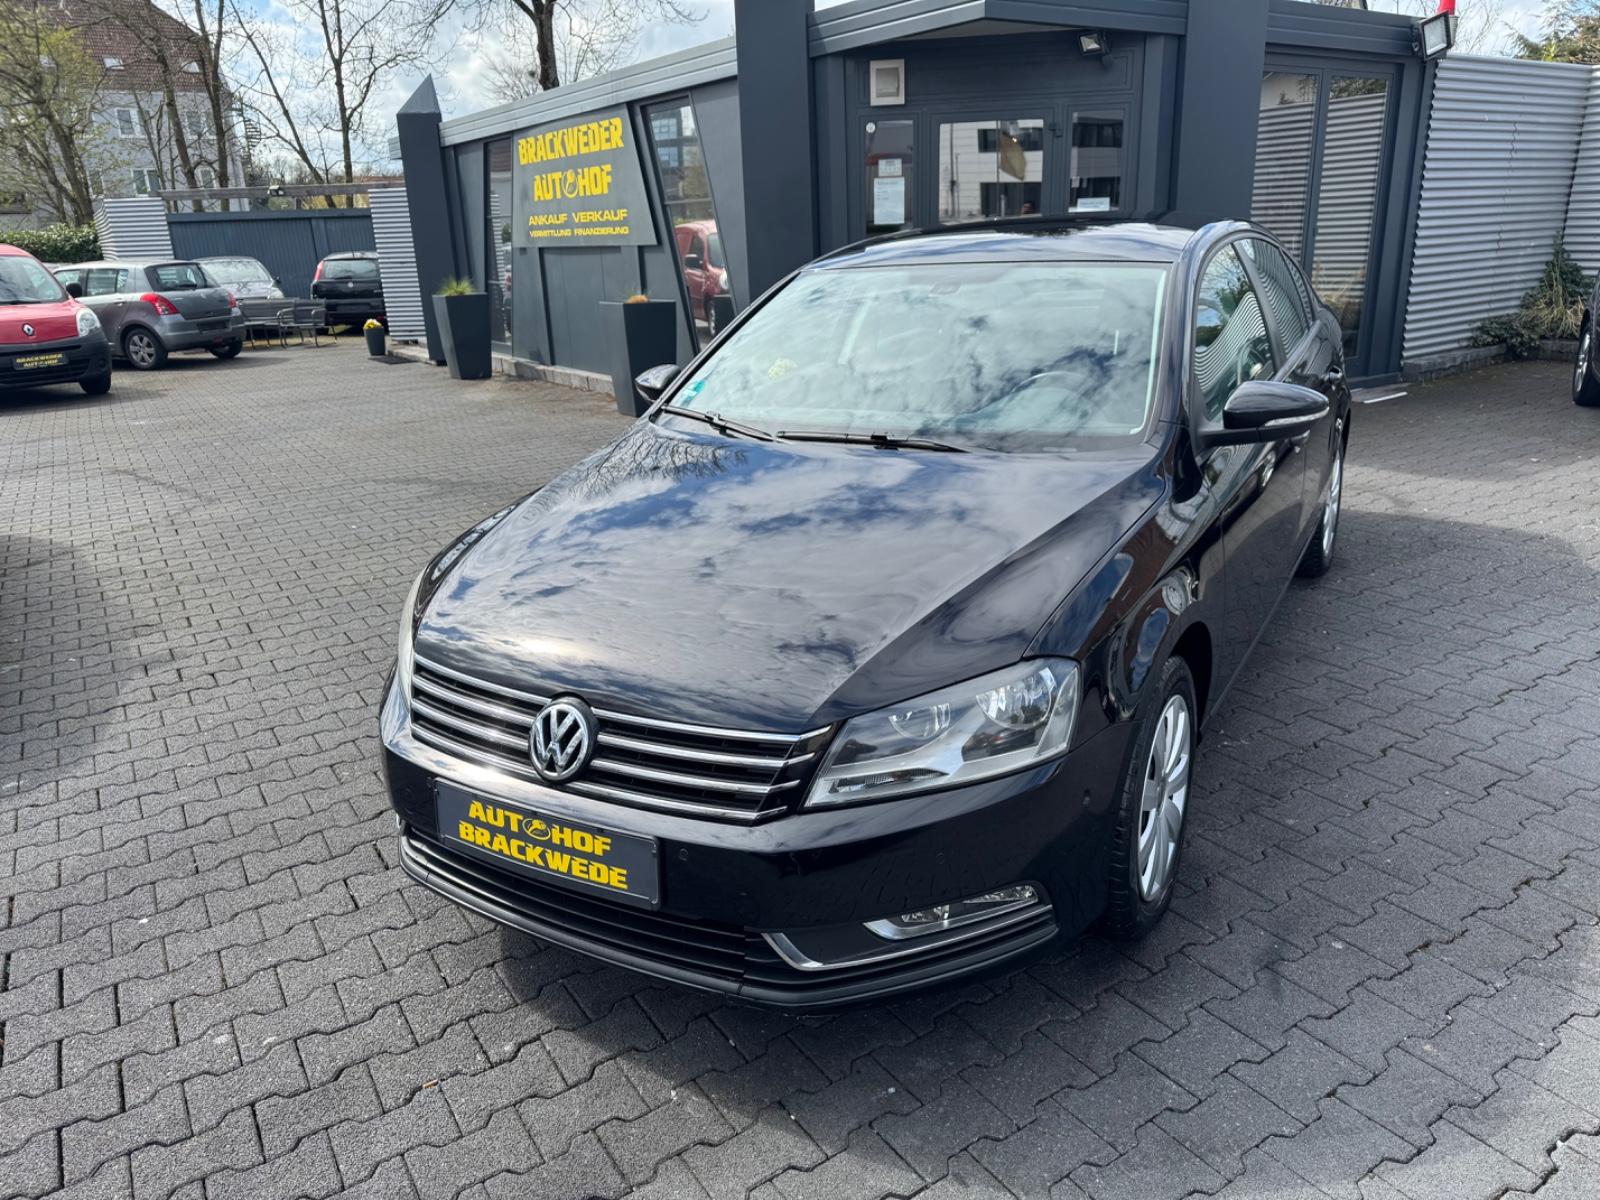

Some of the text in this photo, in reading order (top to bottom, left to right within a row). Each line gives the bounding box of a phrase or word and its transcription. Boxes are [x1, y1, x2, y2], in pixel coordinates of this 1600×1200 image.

[518, 117, 624, 166] BRACKWEDER
[528, 209, 628, 226] ANKAUF VERKAUF
[458, 820, 629, 890] BRACKWEDE
